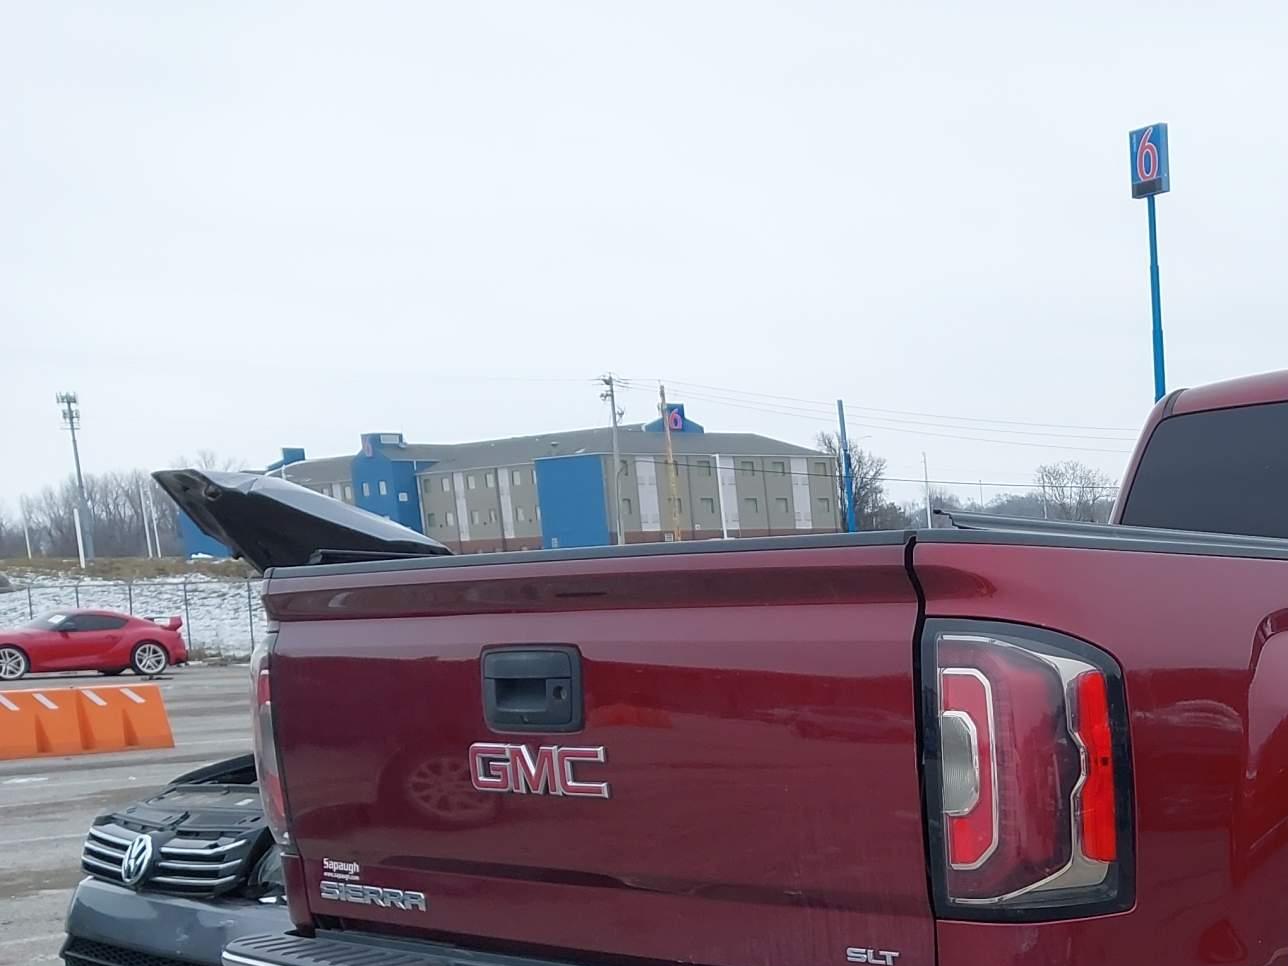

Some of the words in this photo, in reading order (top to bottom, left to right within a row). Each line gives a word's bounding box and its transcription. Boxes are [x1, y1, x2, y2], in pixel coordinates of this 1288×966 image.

[1136, 126, 1159, 181] 6
[469, 742, 609, 799] GMC
[323, 857, 360, 874] Sapaugh
[320, 880, 426, 912] SIERRA
[846, 947, 900, 966] SLT
